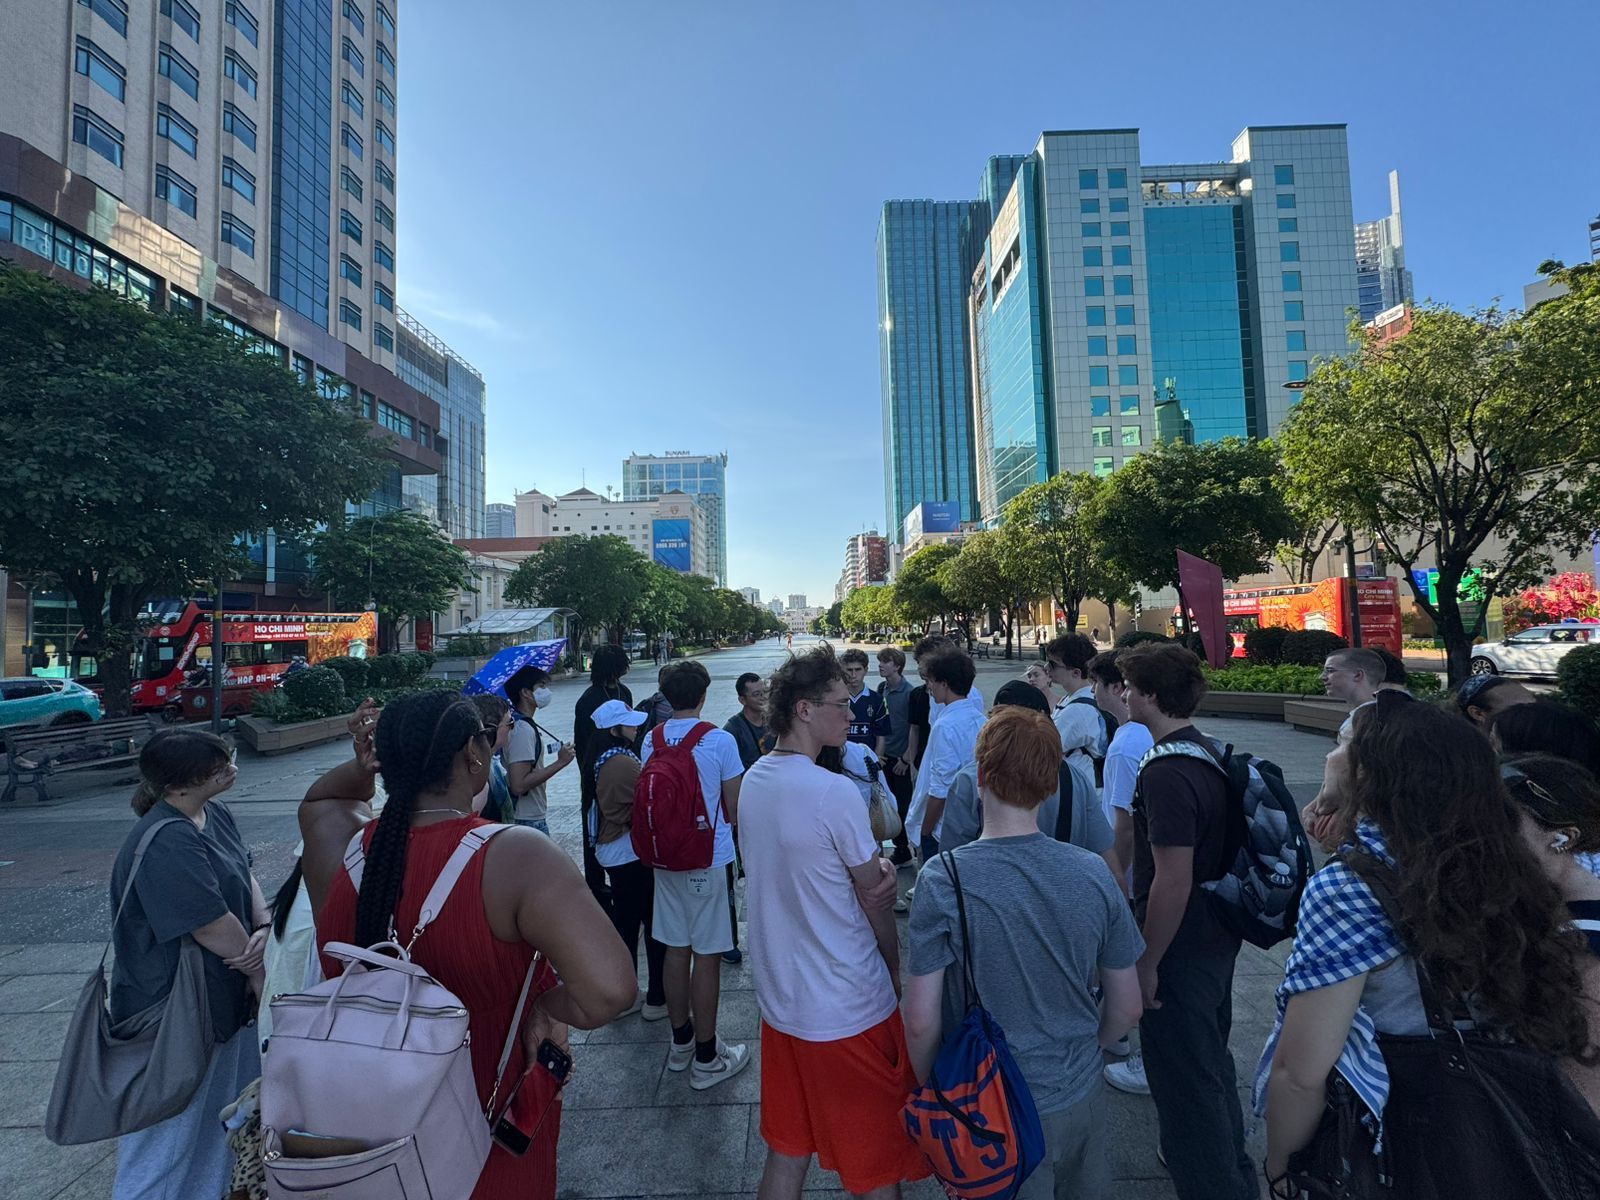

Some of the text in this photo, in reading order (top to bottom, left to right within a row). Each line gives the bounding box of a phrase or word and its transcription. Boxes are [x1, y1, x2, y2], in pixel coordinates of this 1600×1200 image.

[254, 624, 304, 633] HO CHI MINH
[237, 675, 254, 685] HOP
